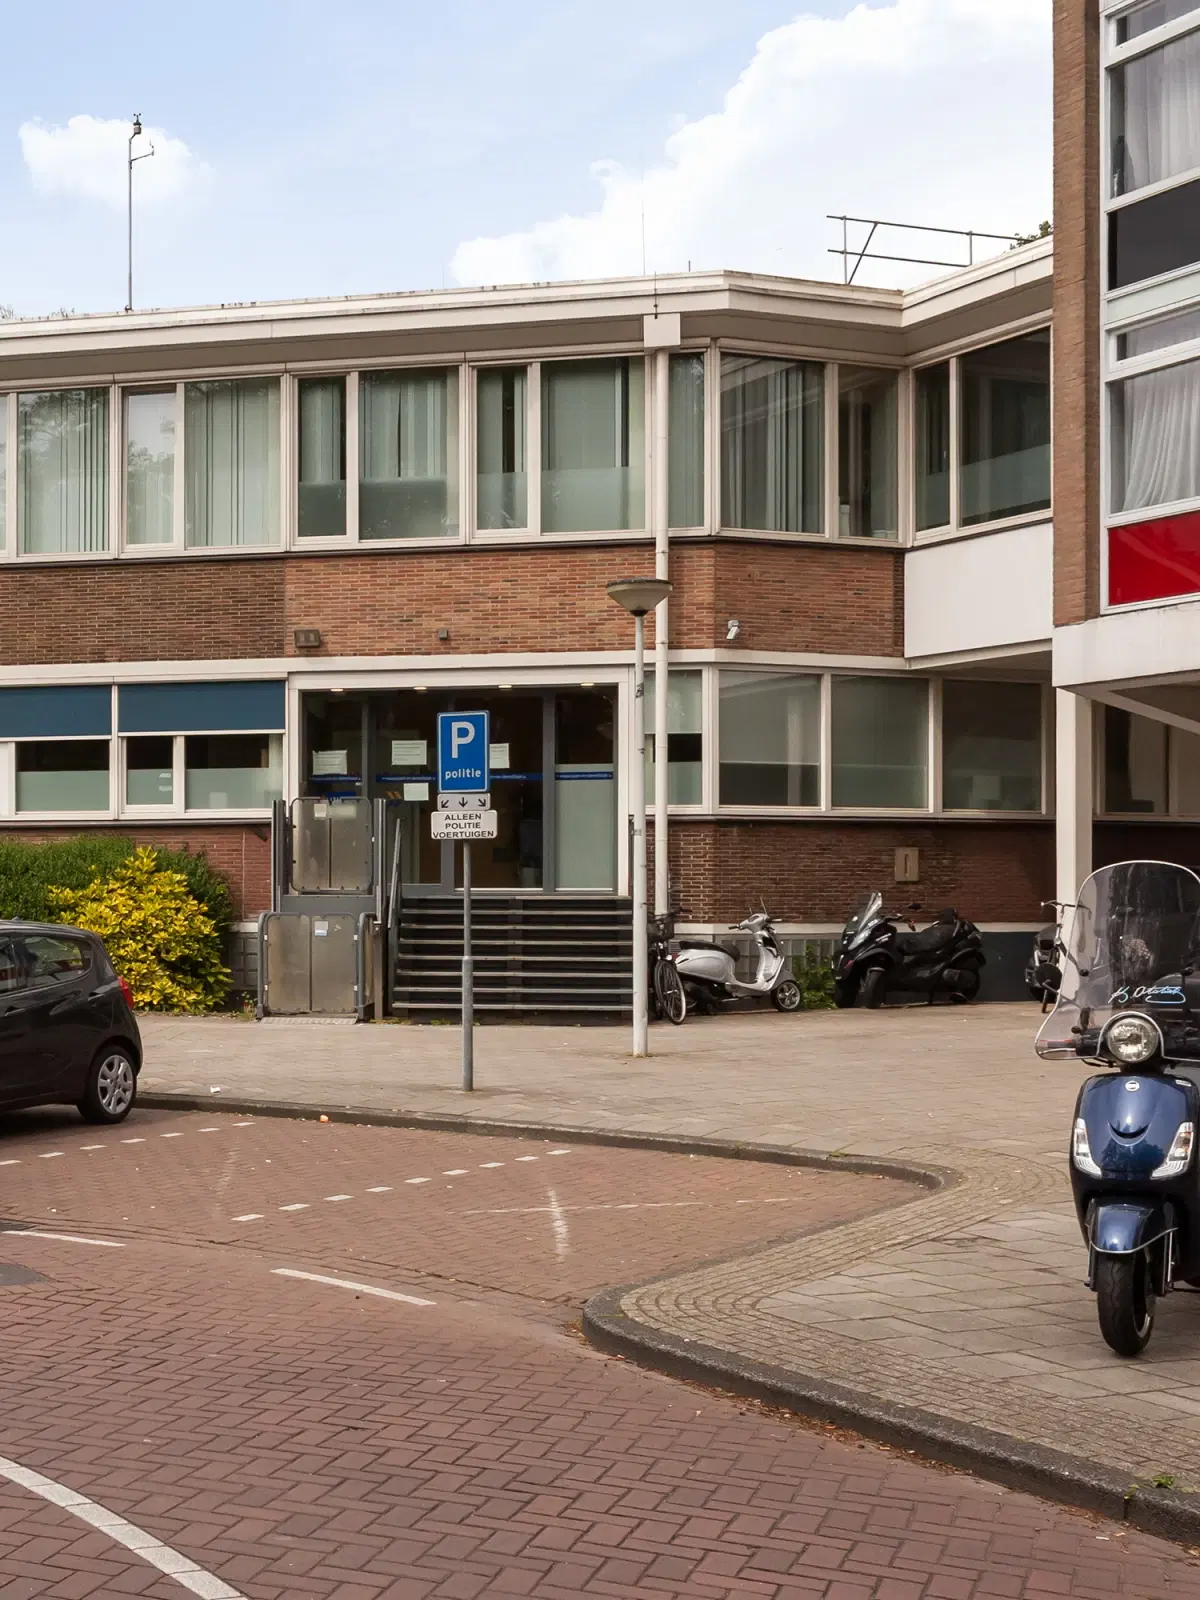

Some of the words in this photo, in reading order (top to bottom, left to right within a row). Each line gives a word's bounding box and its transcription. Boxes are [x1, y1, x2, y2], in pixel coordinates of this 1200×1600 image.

[451, 721, 476, 759] P
[445, 768, 482, 780] politie
[444, 813, 482, 821] ALLEEN
